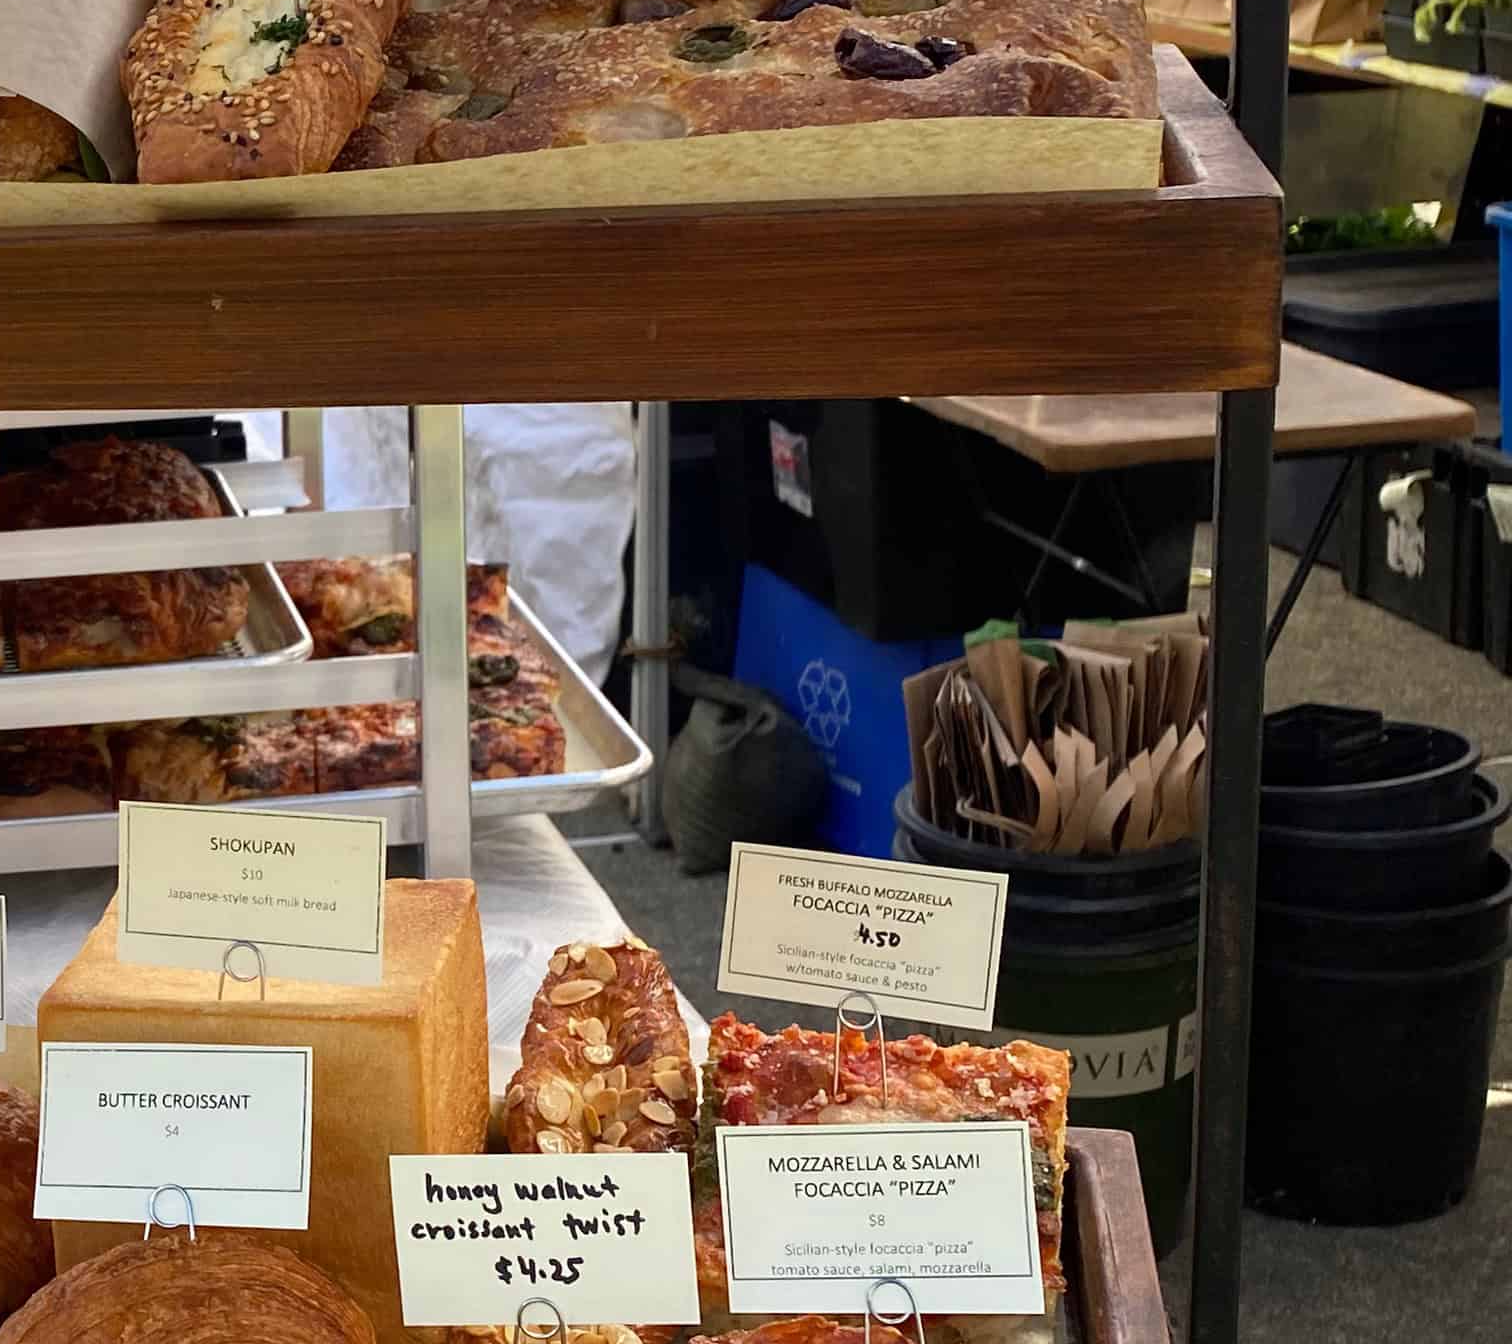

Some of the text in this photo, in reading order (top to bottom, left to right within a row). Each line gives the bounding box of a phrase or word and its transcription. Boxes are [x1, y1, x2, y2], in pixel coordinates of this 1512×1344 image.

[209, 836, 295, 856] SHOKUPAN
[240, 866, 263, 880] $10
[167, 887, 337, 912] Japanese-style soft milk bread
[777, 873, 953, 907] FRESH BUFFALO MOZZARELLA
[792, 893, 870, 917] FOCACCIA
[775, 942, 847, 964] Sicilian-style
[848, 952, 896, 971] focaccia
[785, 961, 927, 992] w/tomato sauce & pesto
[97, 1092, 251, 1109] BUTTER CROISSANT
[164, 1123, 179, 1138] $4
[768, 1153, 980, 1172] MOZZARELLA & SALAMI
[424, 1172, 620, 1215] honey walnut
[793, 1181, 884, 1198] FOCACCIA
[410, 1207, 646, 1241] croissant twist
[867, 1212, 885, 1228] $8
[783, 1241, 866, 1257] Sicilian-style
[869, 1241, 924, 1255] focaccia
[494, 1254, 584, 1285] $4.25
[770, 1264, 820, 1276] tomato
[918, 1260, 992, 1274] mozzarella
